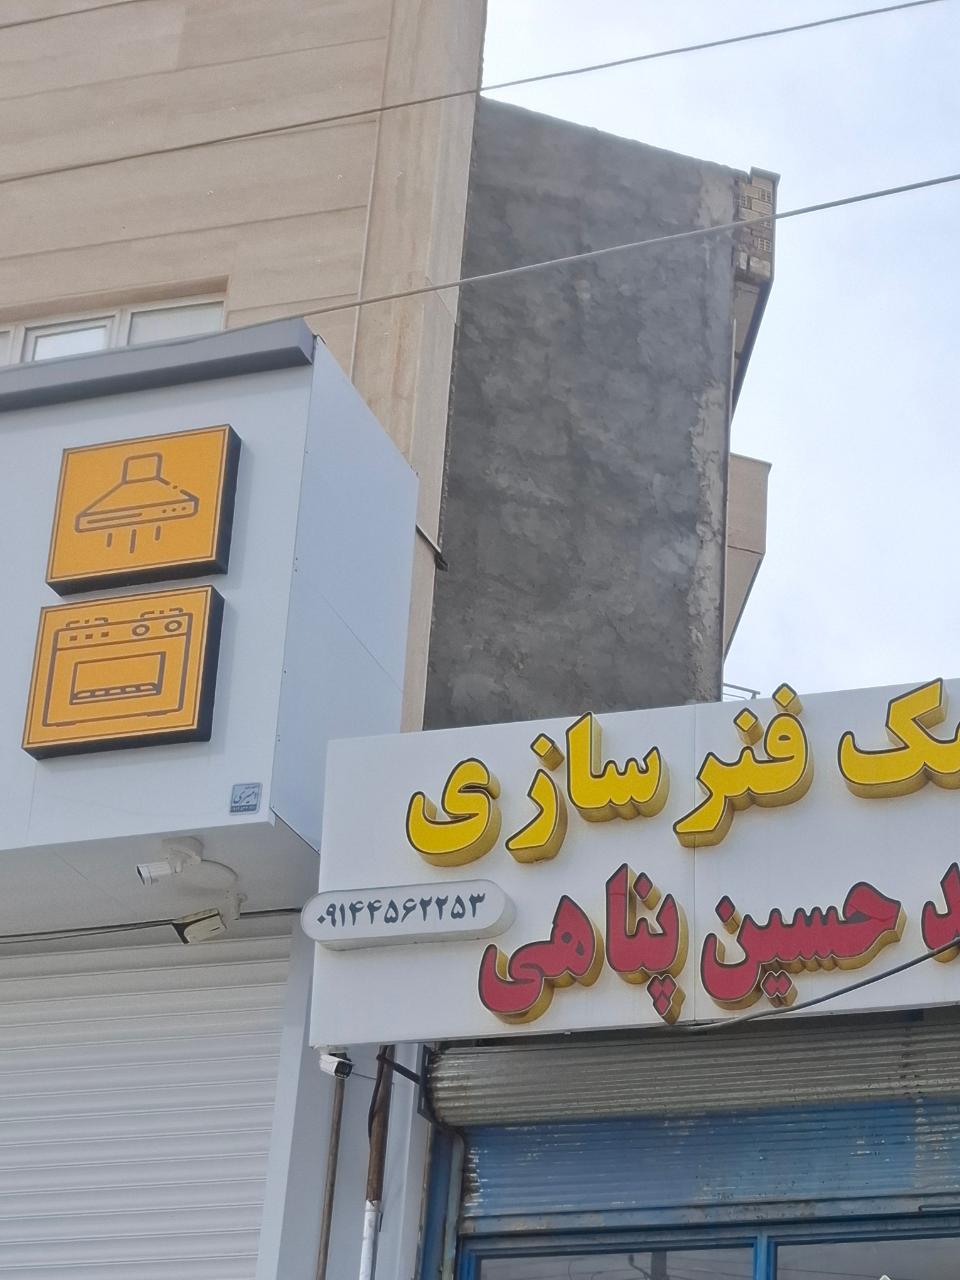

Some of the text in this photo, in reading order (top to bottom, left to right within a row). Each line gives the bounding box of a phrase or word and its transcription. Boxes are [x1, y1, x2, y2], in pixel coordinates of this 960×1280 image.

[673, 684, 813, 847] فنر
[317, 893, 486, 928] ۰۹۱۴۴۵۶۲۲۵۳
[478, 863, 688, 1024] پناهی
[700, 881, 906, 1009] حسین
